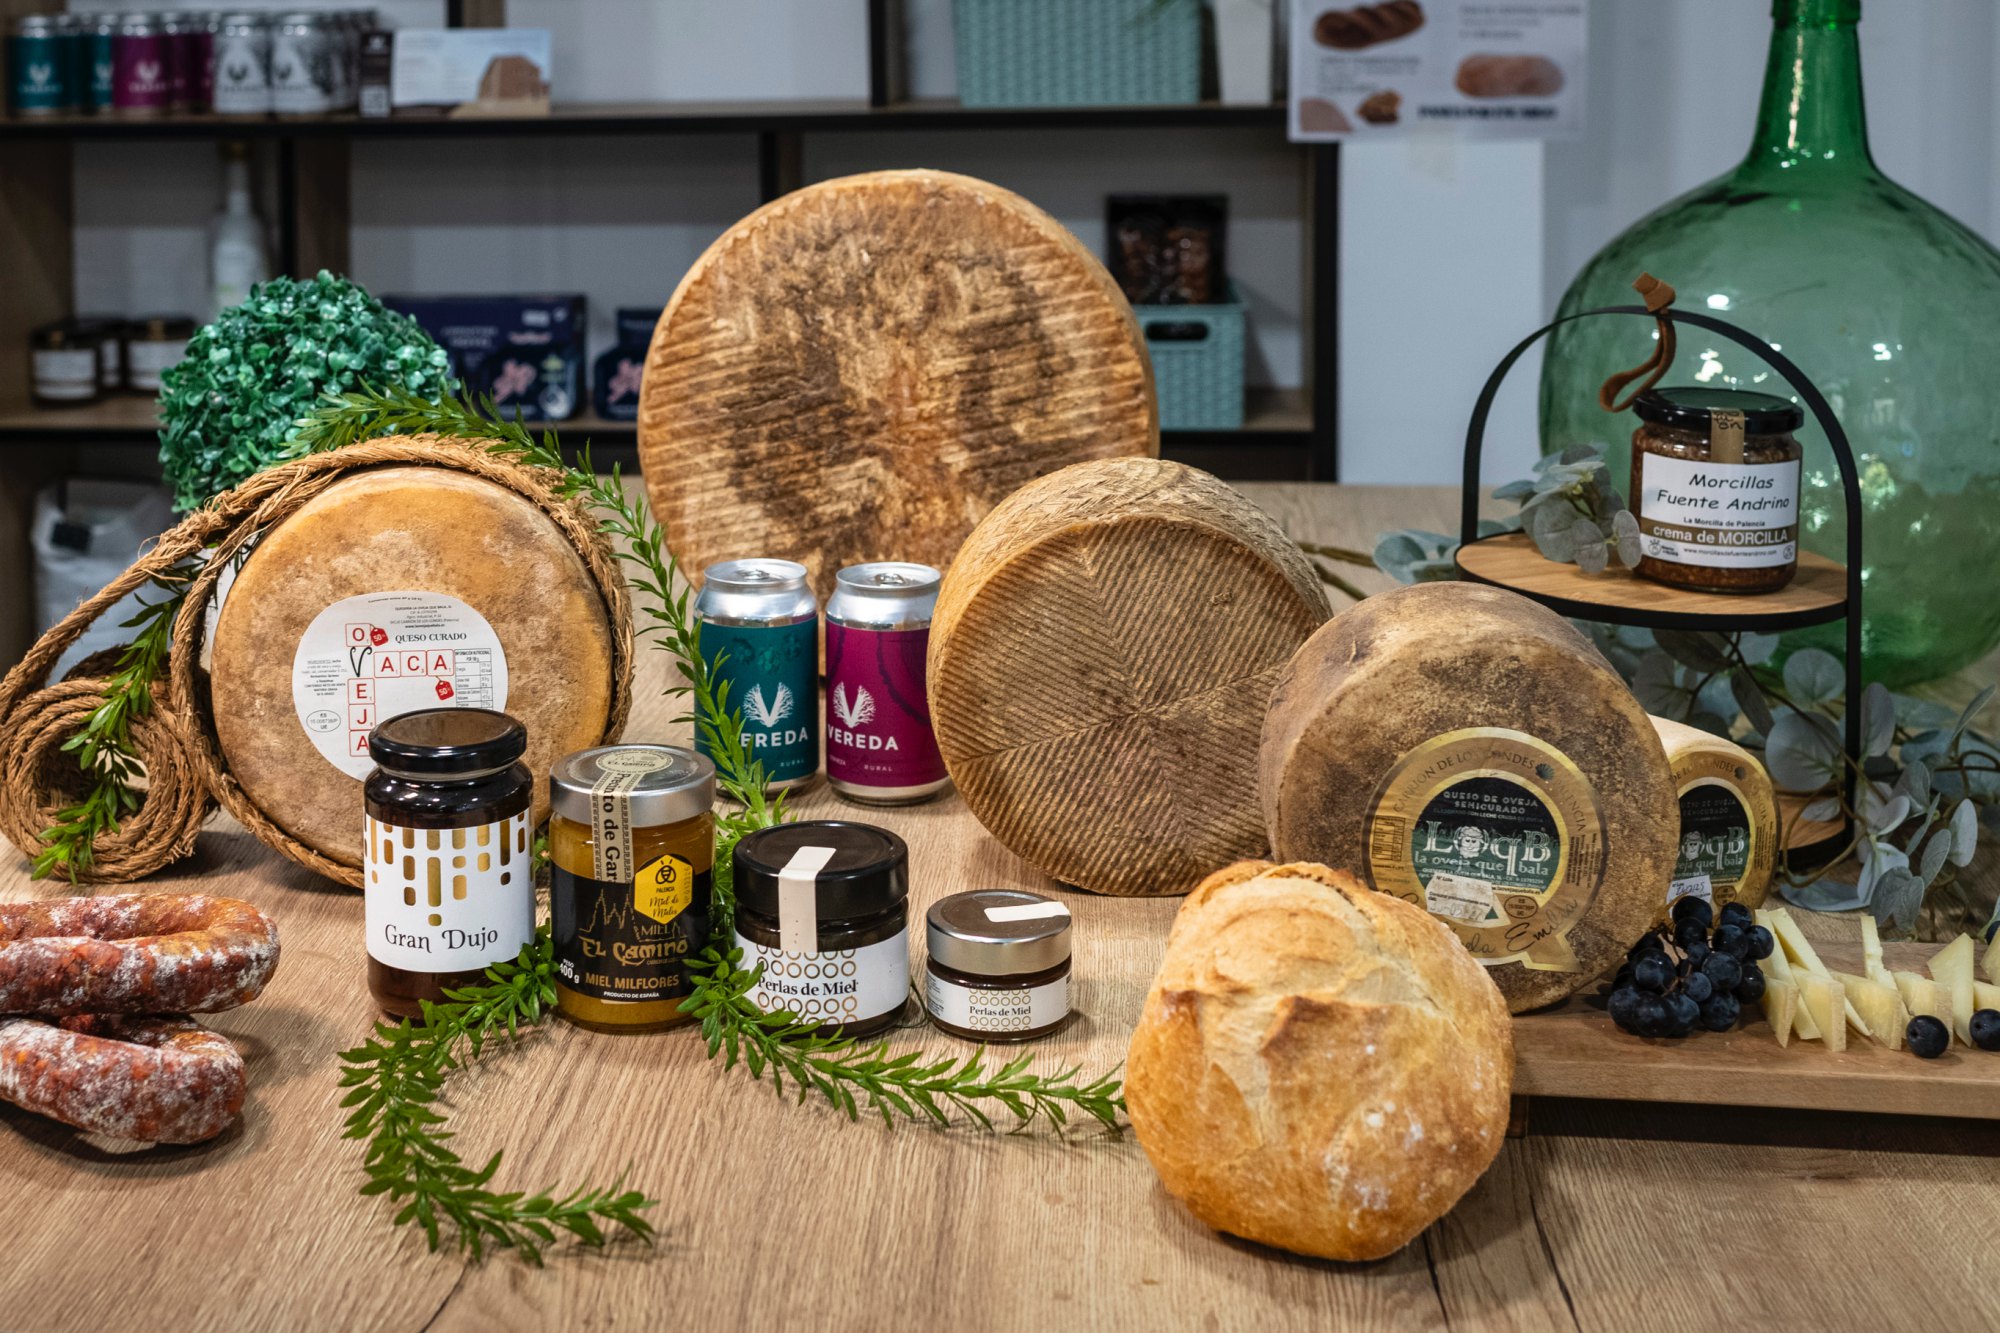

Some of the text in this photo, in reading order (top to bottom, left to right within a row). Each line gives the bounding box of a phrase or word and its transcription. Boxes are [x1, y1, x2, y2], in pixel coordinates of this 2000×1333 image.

[1689, 473, 1775, 489] Morcillas
[1657, 489, 1790, 511] Fuente Andrino
[1683, 516, 1692, 524] La
[1694, 518, 1723, 527] Morcilla
[1725, 519, 1734, 527] de
[1653, 526, 1788, 545] crema de MORCILLA
[395, 632, 467, 644] QUESO CURADO
[740, 727, 808, 748] EREDA
[827, 724, 899, 751] VEREDA
[864, 764, 893, 772] RURAL
[1436, 757, 1455, 771] DE
[1443, 790, 1538, 807] QUESO DE OVEJA
[1454, 800, 1526, 814] SEMICURADO
[602, 773, 632, 882] Precinto de Gar
[1414, 850, 1549, 876] la oveja que bala
[385, 924, 498, 954] Gran Dujo
[578, 935, 607, 958] EL
[563, 958, 575, 968] PESO
[574, 974, 580, 984] g
[585, 972, 680, 990] MIEL MILFLORES
[758, 976, 857, 996] Perlas de Miel
[639, 991, 660, 999] ESPAÑA
[969, 1006, 1031, 1016] Perlas de Miel
